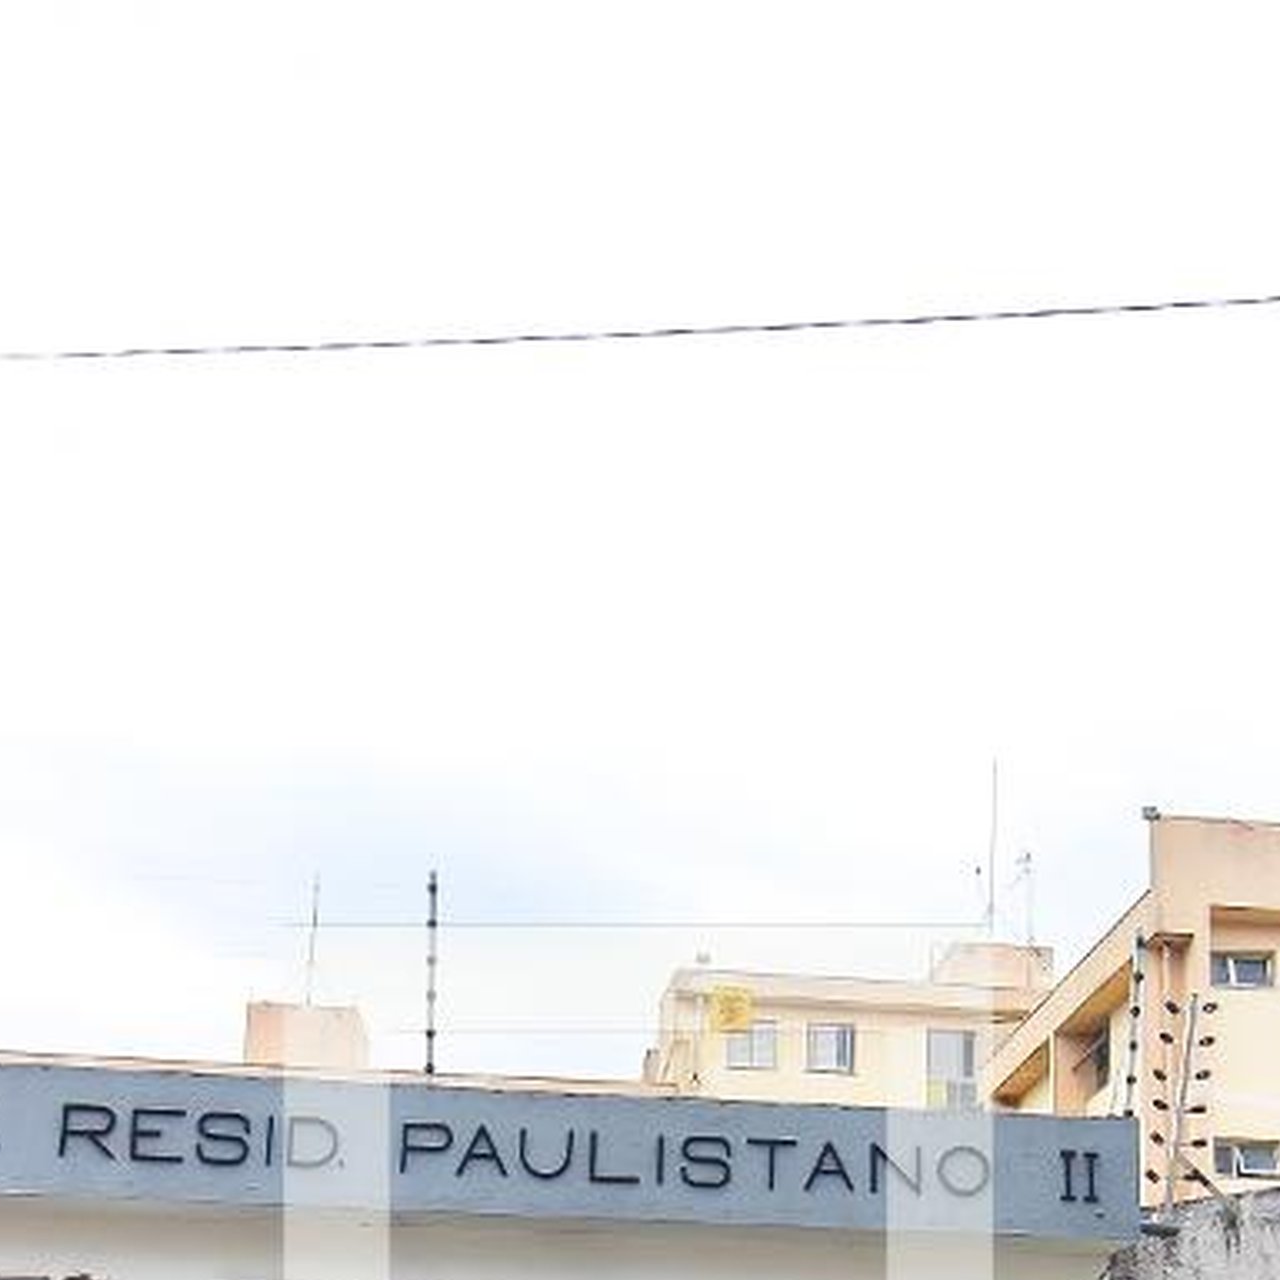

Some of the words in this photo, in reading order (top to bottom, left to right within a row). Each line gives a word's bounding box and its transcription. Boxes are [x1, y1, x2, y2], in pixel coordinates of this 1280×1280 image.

[57, 1102, 344, 1168] RESID.
[399, 1122, 989, 1198] PAULISTANO
[1060, 1149, 1099, 1202] II
